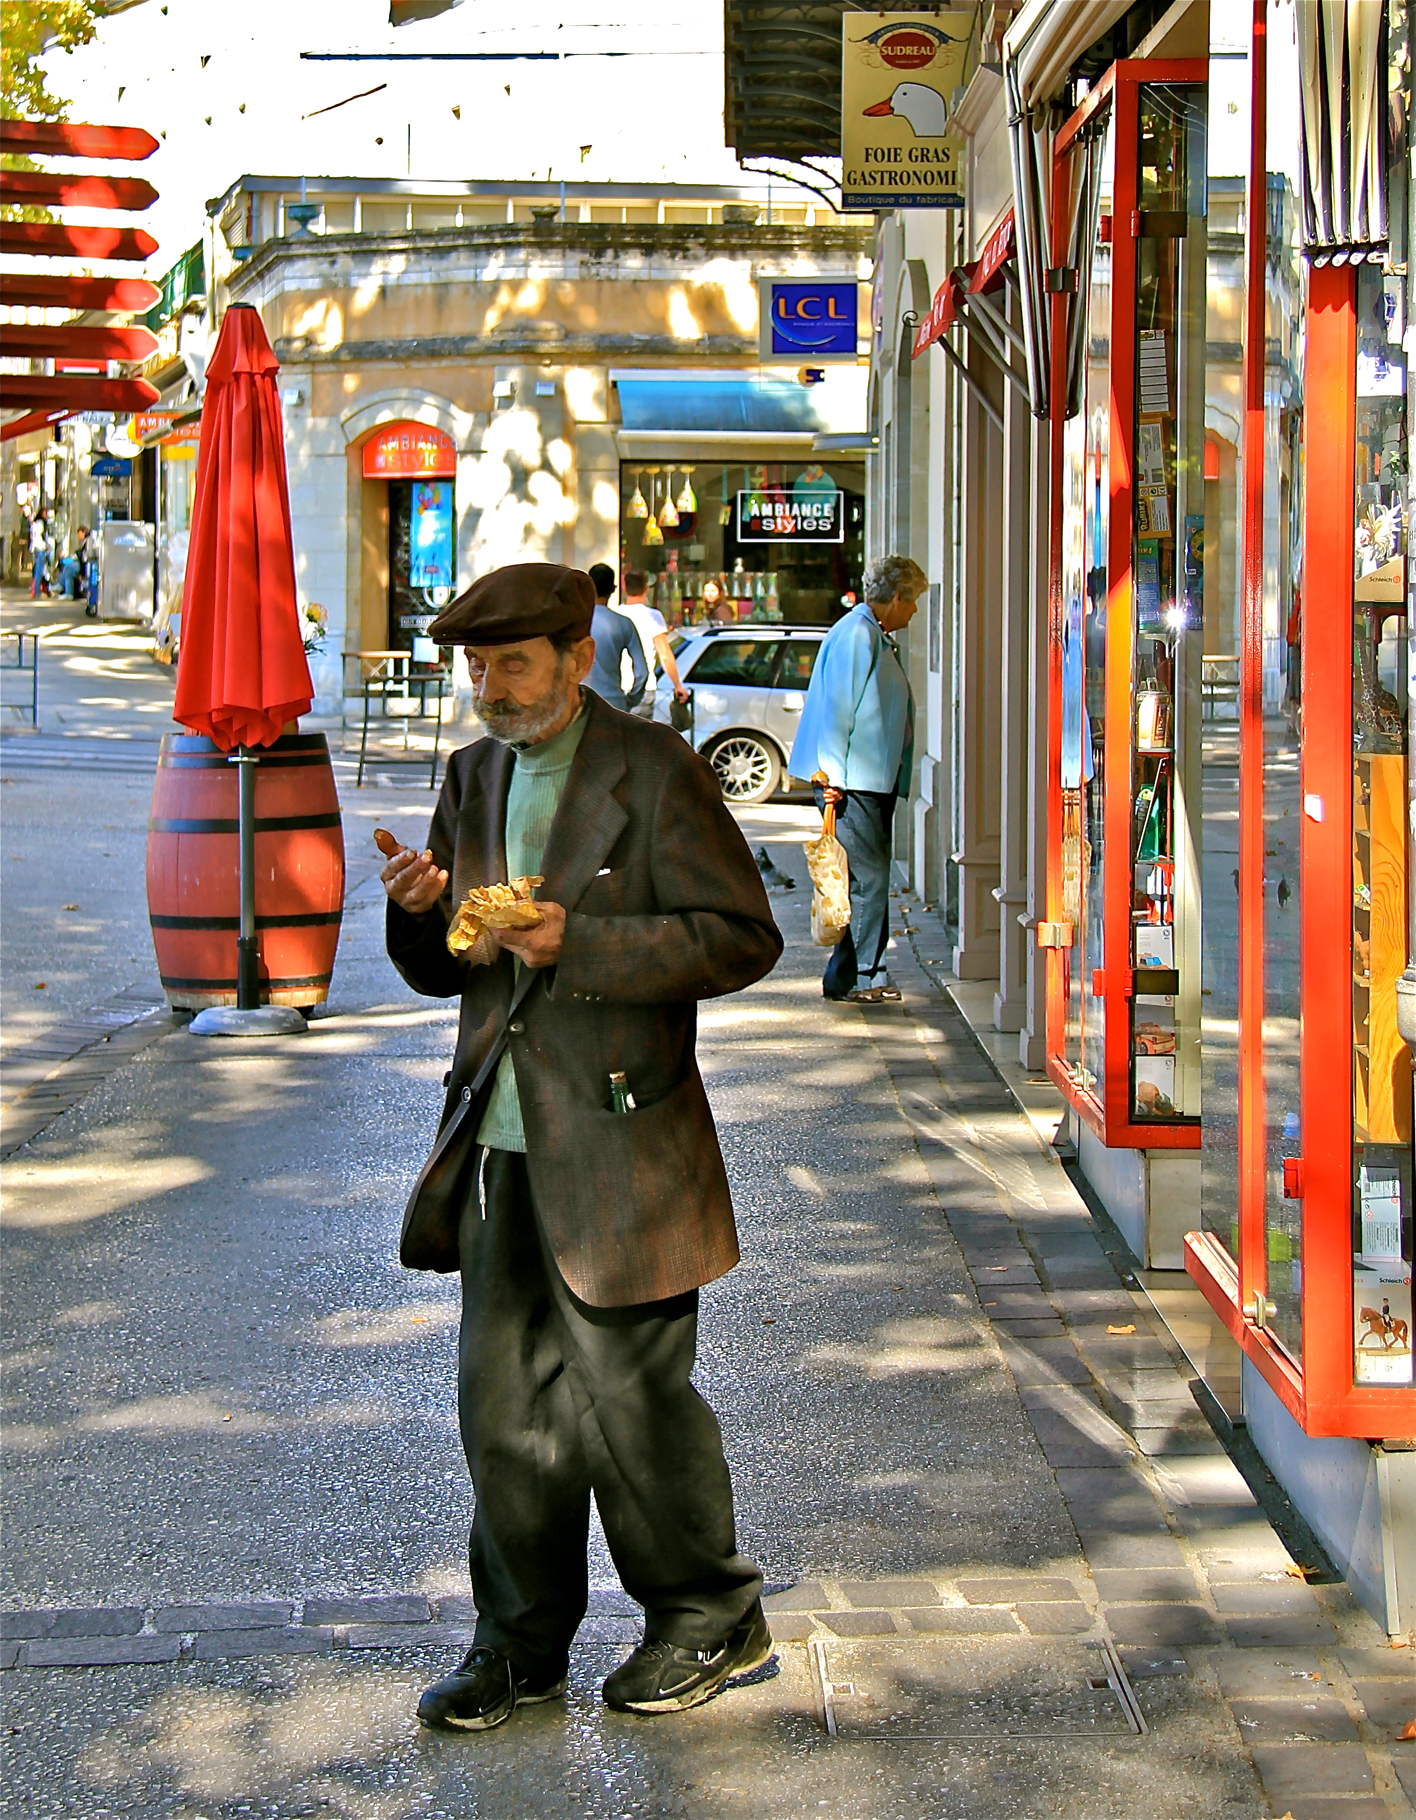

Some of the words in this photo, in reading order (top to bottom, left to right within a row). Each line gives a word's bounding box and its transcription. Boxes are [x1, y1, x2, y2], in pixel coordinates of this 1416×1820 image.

[881, 46, 935, 56] SUDREAU
[864, 147, 903, 163] FOIE
[908, 147, 951, 163] GRAS
[847, 170, 957, 186] GASTRONOMI
[848, 196, 895, 204] Boutique
[778, 296, 848, 319] LCL
[751, 503, 832, 517] AMBIANCE
[762, 517, 832, 533] styles
